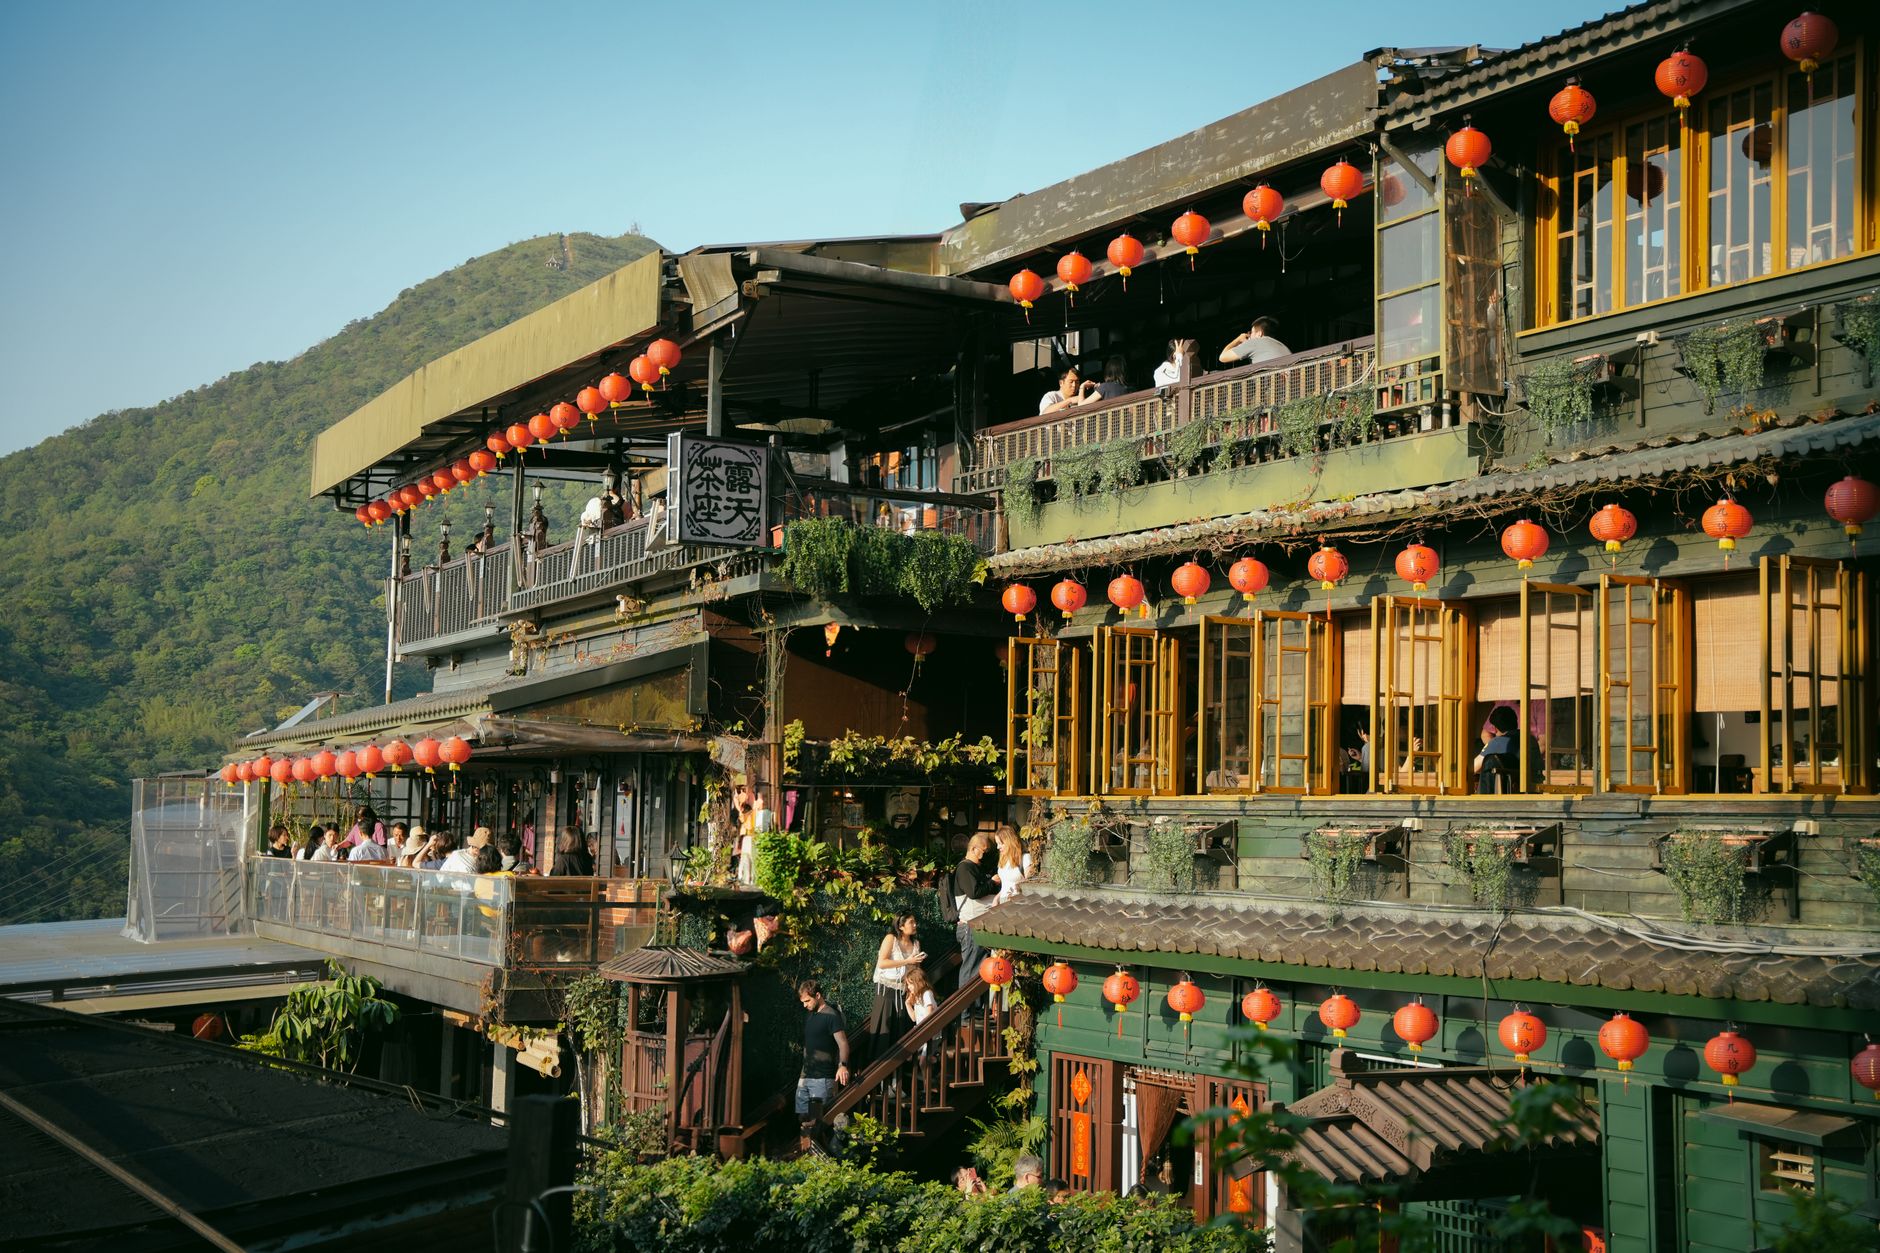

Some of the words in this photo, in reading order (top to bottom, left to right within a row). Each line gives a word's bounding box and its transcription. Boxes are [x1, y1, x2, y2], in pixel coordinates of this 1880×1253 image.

[688, 456, 724, 524] 茶座
[723, 459, 760, 525] 露天
[1717, 507, 1728, 532] 九份
[1415, 552, 1426, 576] 九份
[993, 962, 1003, 984] 九份
[1120, 981, 1130, 1004] 九份
[1519, 1022, 1531, 1048] 九份
[1727, 1043, 1739, 1070] 九份
